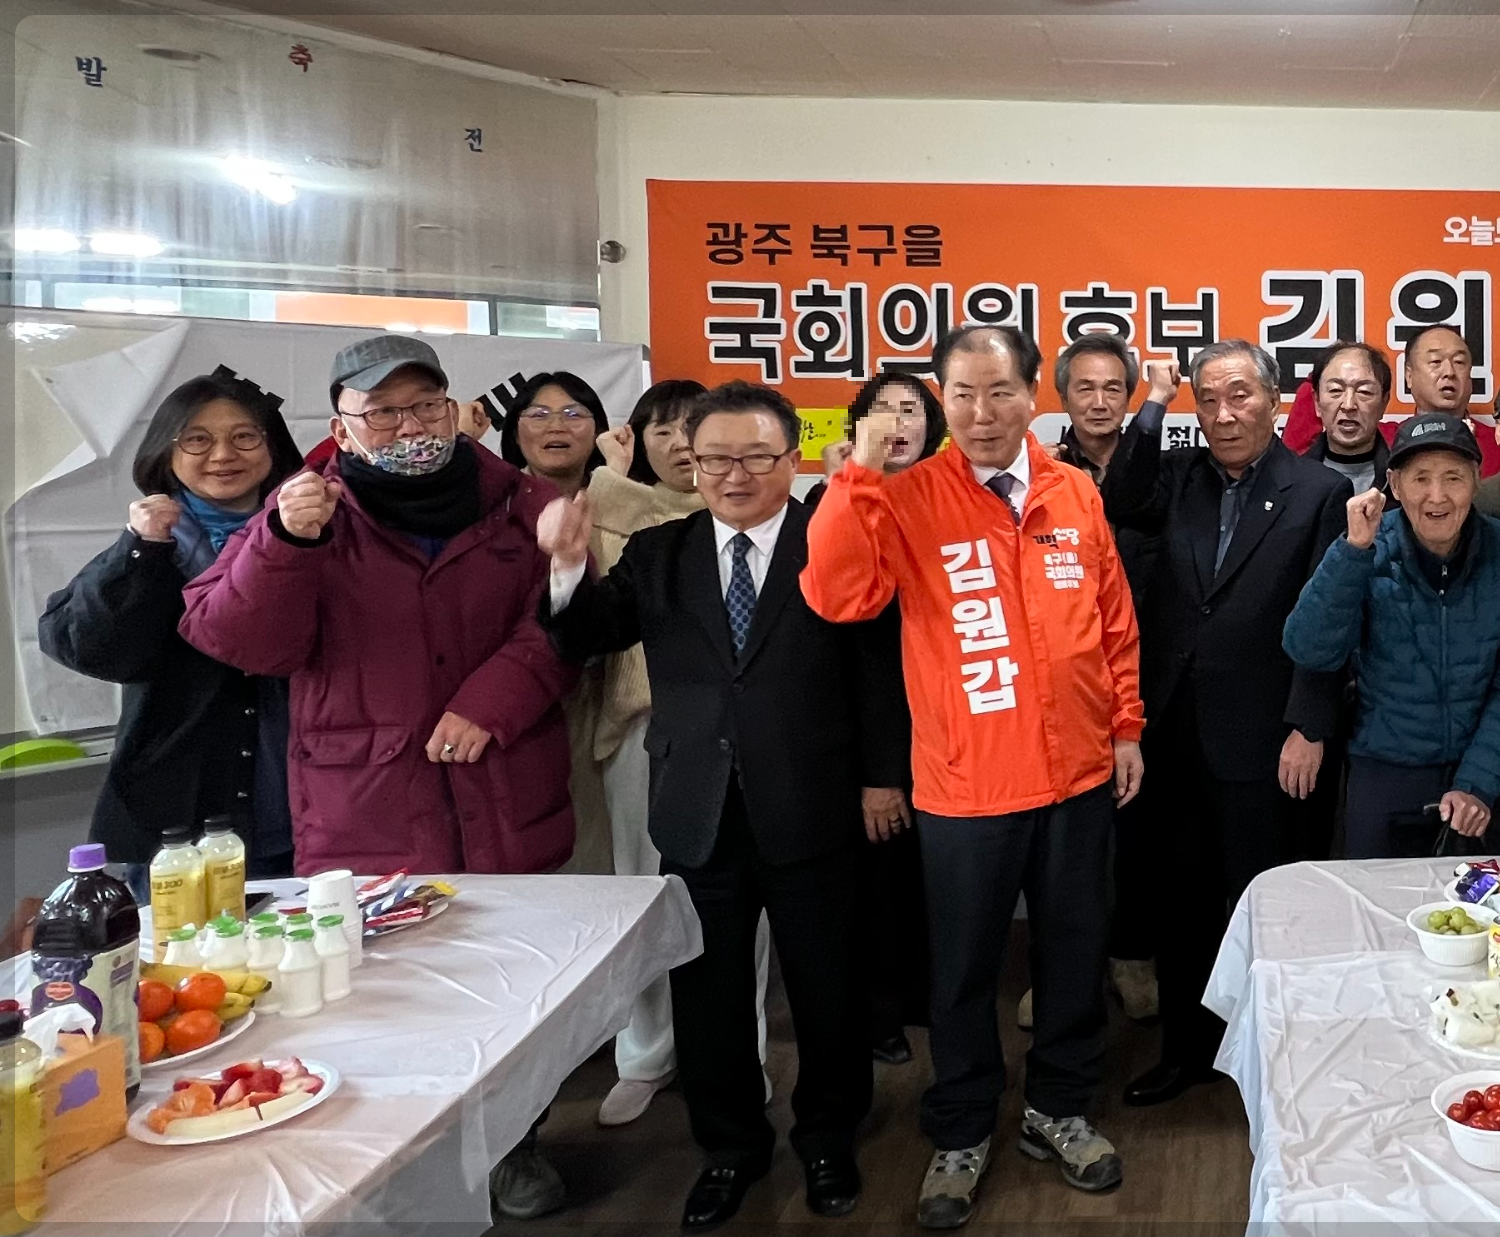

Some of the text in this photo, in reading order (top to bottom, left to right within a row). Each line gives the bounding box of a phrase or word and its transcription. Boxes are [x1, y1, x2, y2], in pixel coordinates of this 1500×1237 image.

[288, 44, 313, 73] 축
[75, 56, 483, 153] 발 전
[706, 221, 943, 268] 광주 북구을
[940, 538, 1020, 715] 김원갑
